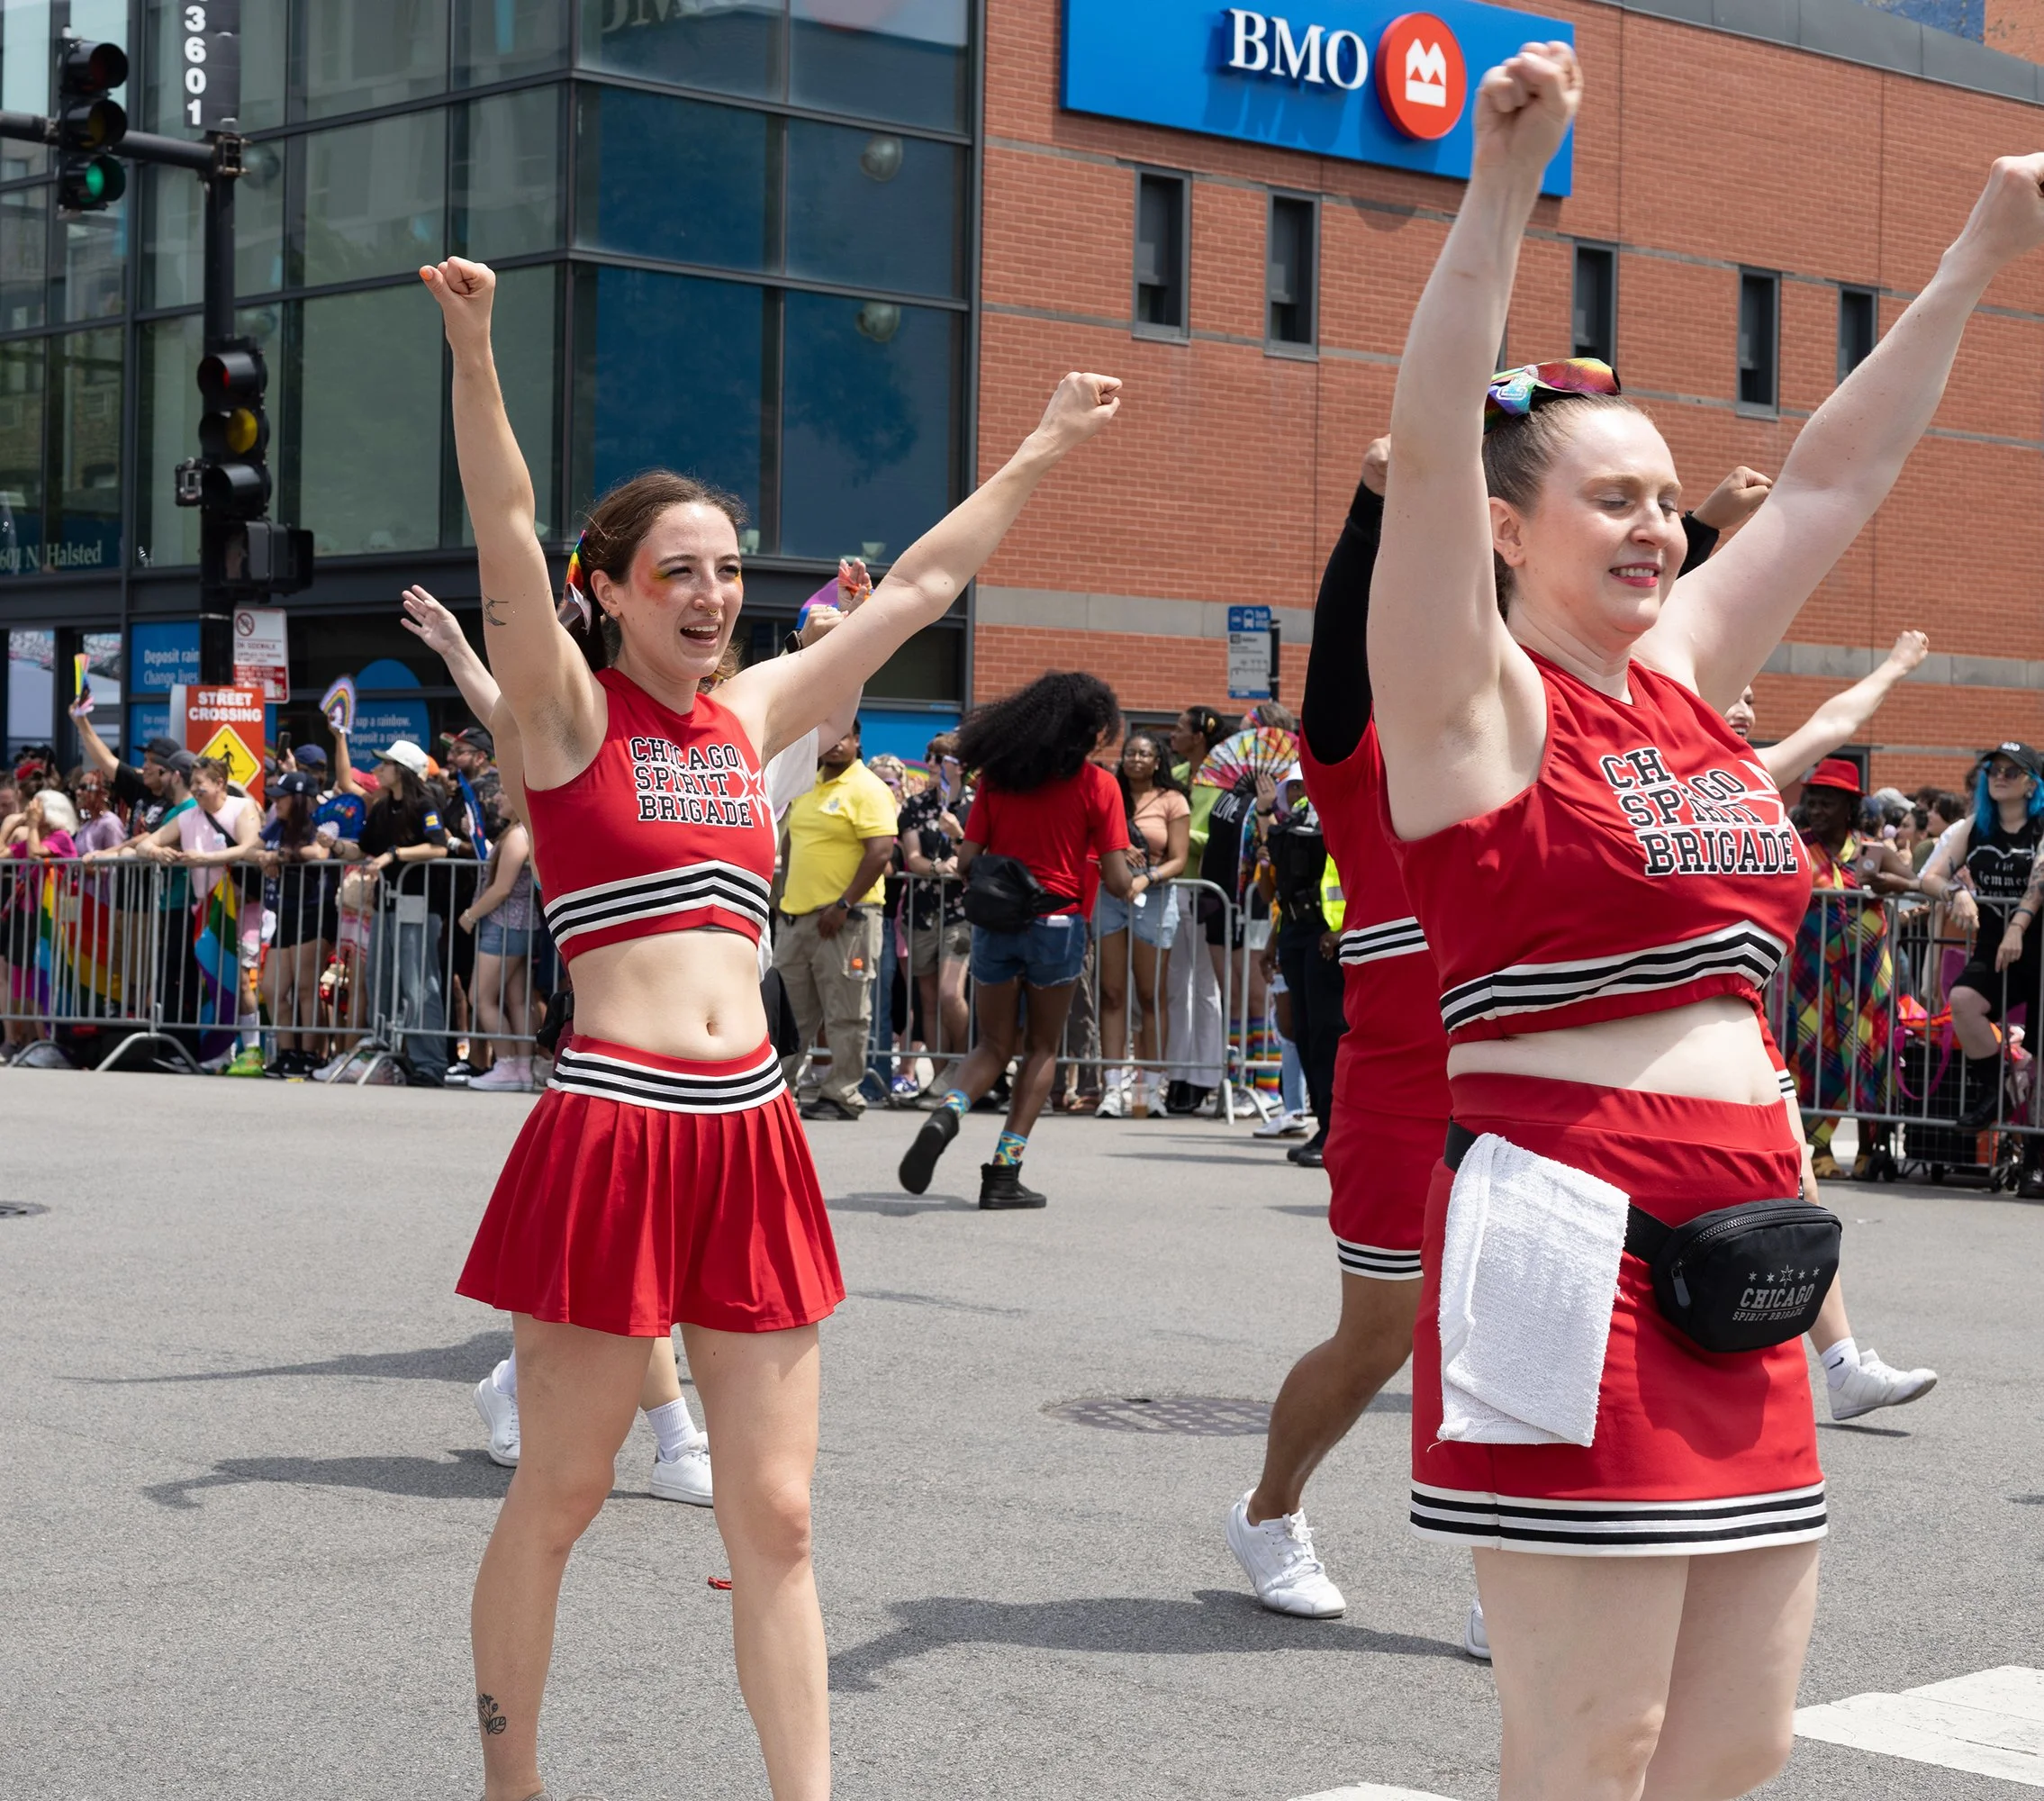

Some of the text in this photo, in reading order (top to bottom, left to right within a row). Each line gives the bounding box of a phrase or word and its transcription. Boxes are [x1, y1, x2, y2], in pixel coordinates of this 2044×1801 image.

[1228, 7, 1369, 90] BMO
[185, 5, 206, 125] 3601
[26, 545, 40, 569] N
[47, 539, 102, 566] Halsted
[144, 647, 179, 666] Deposit
[144, 669, 176, 688] Change
[198, 691, 253, 706] STREET
[188, 707, 262, 722] CROSSING
[630, 737, 739, 771] CHICAGO
[634, 765, 730, 796] SPIRIT
[1599, 747, 1748, 802] CHGO
[638, 795, 755, 828] BRIGADE
[1637, 829, 1798, 876] BRIGADE
[1740, 1283, 1815, 1308] CHICAGO
[1732, 1307, 1805, 1321] SPIRIT BRIGADE
